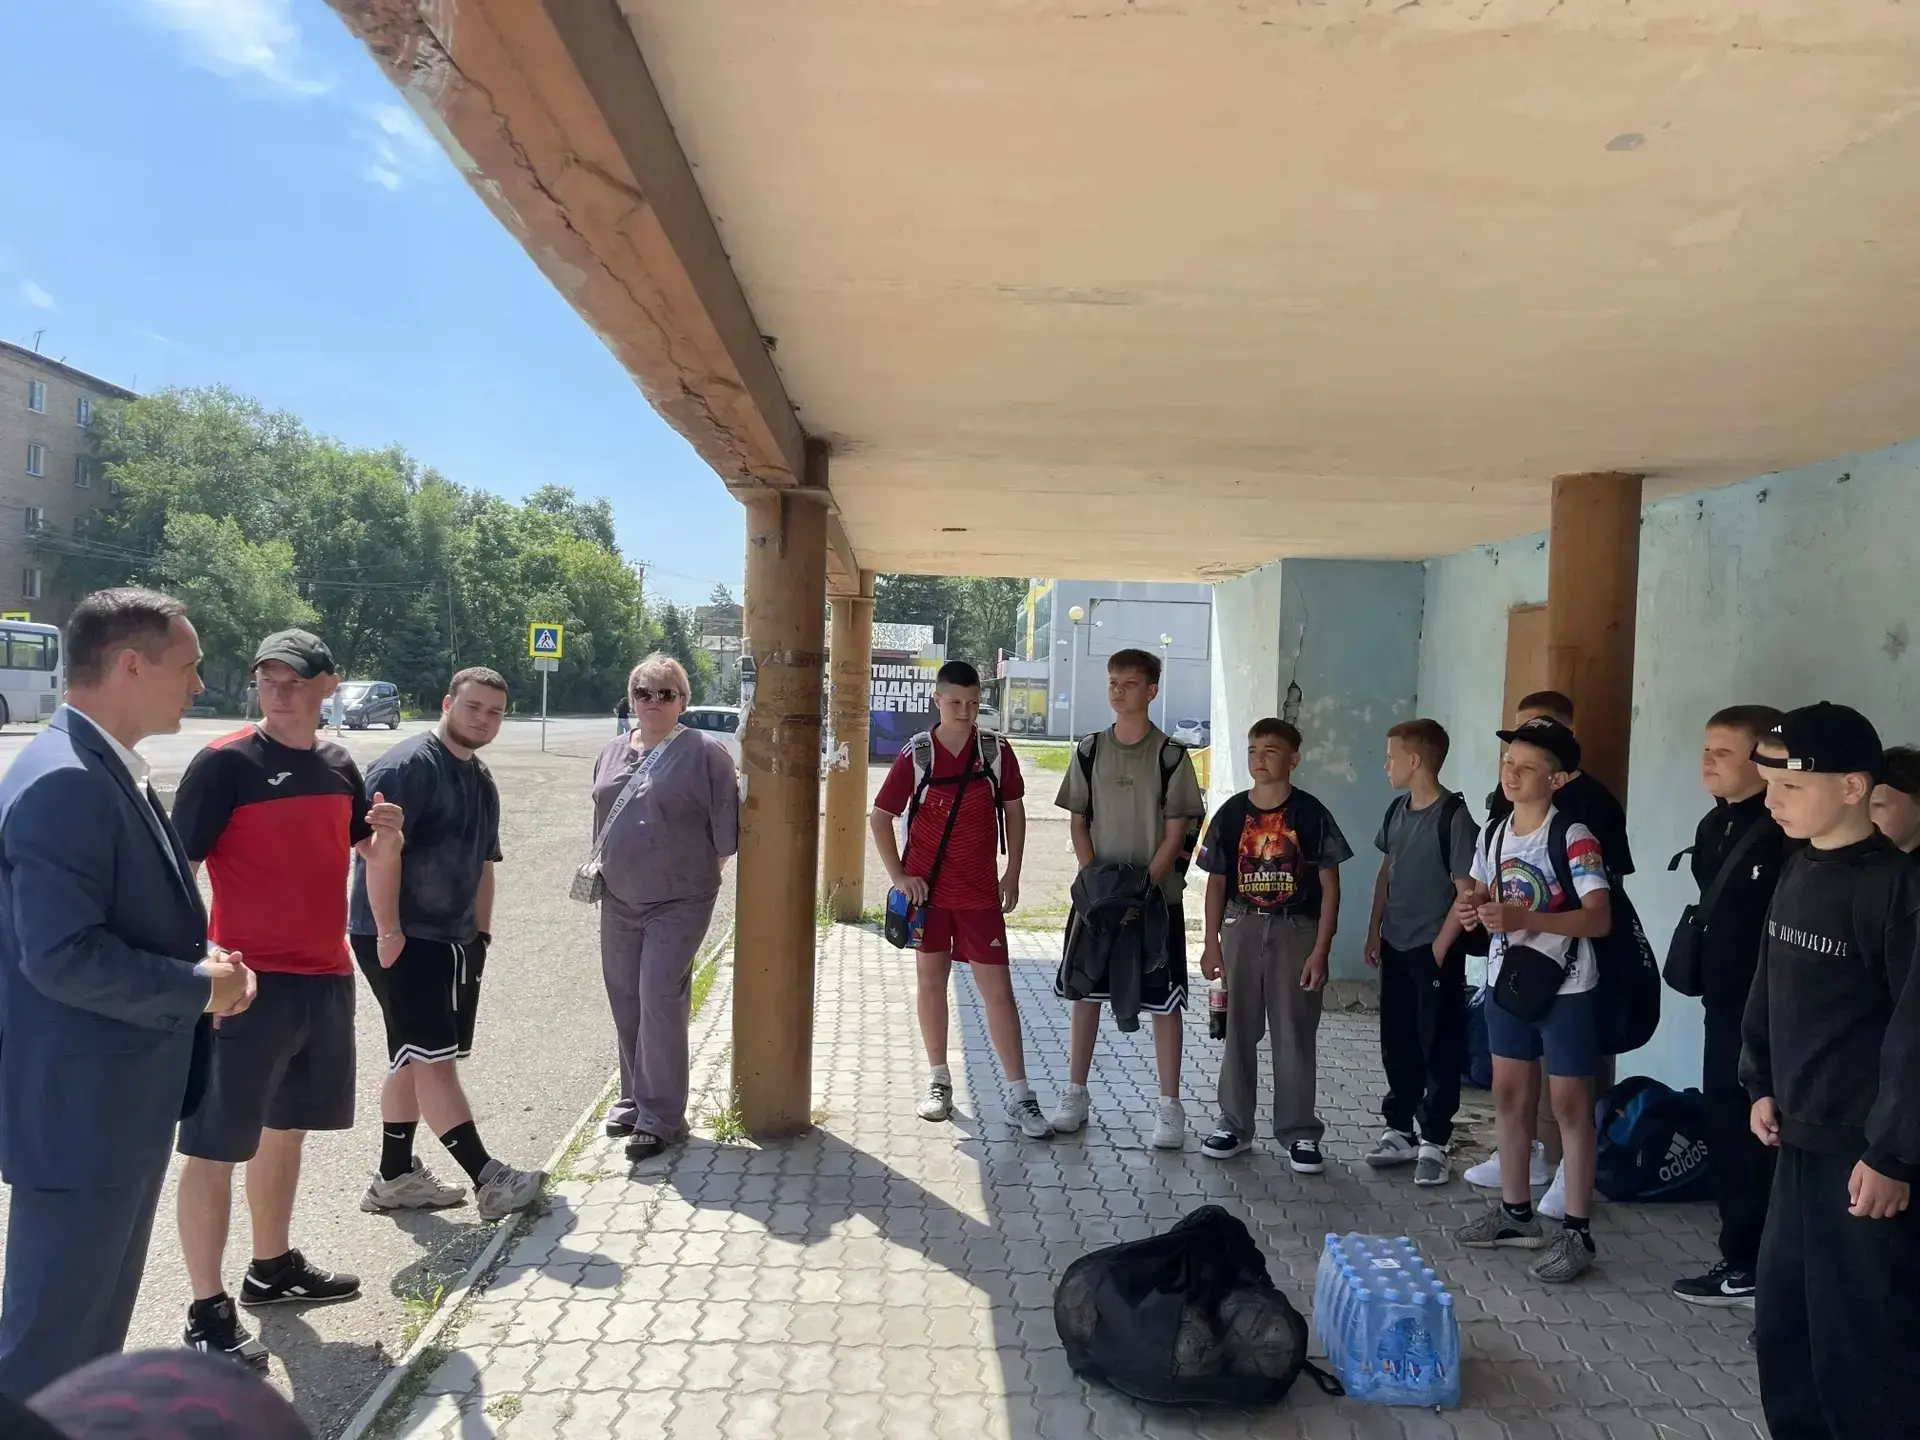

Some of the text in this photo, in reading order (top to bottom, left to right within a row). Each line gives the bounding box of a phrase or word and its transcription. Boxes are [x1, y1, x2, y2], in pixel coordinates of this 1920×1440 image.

[870, 695, 930, 713] ВЕТЫ!
[639, 751, 659, 775] GUESS
[608, 798, 625, 824] GUESS
[1239, 882, 1297, 893] ПОКОЛЕНИ
[1243, 871, 1294, 883] ПАМЯТЬ
[1659, 1140, 1708, 1181] adidas
